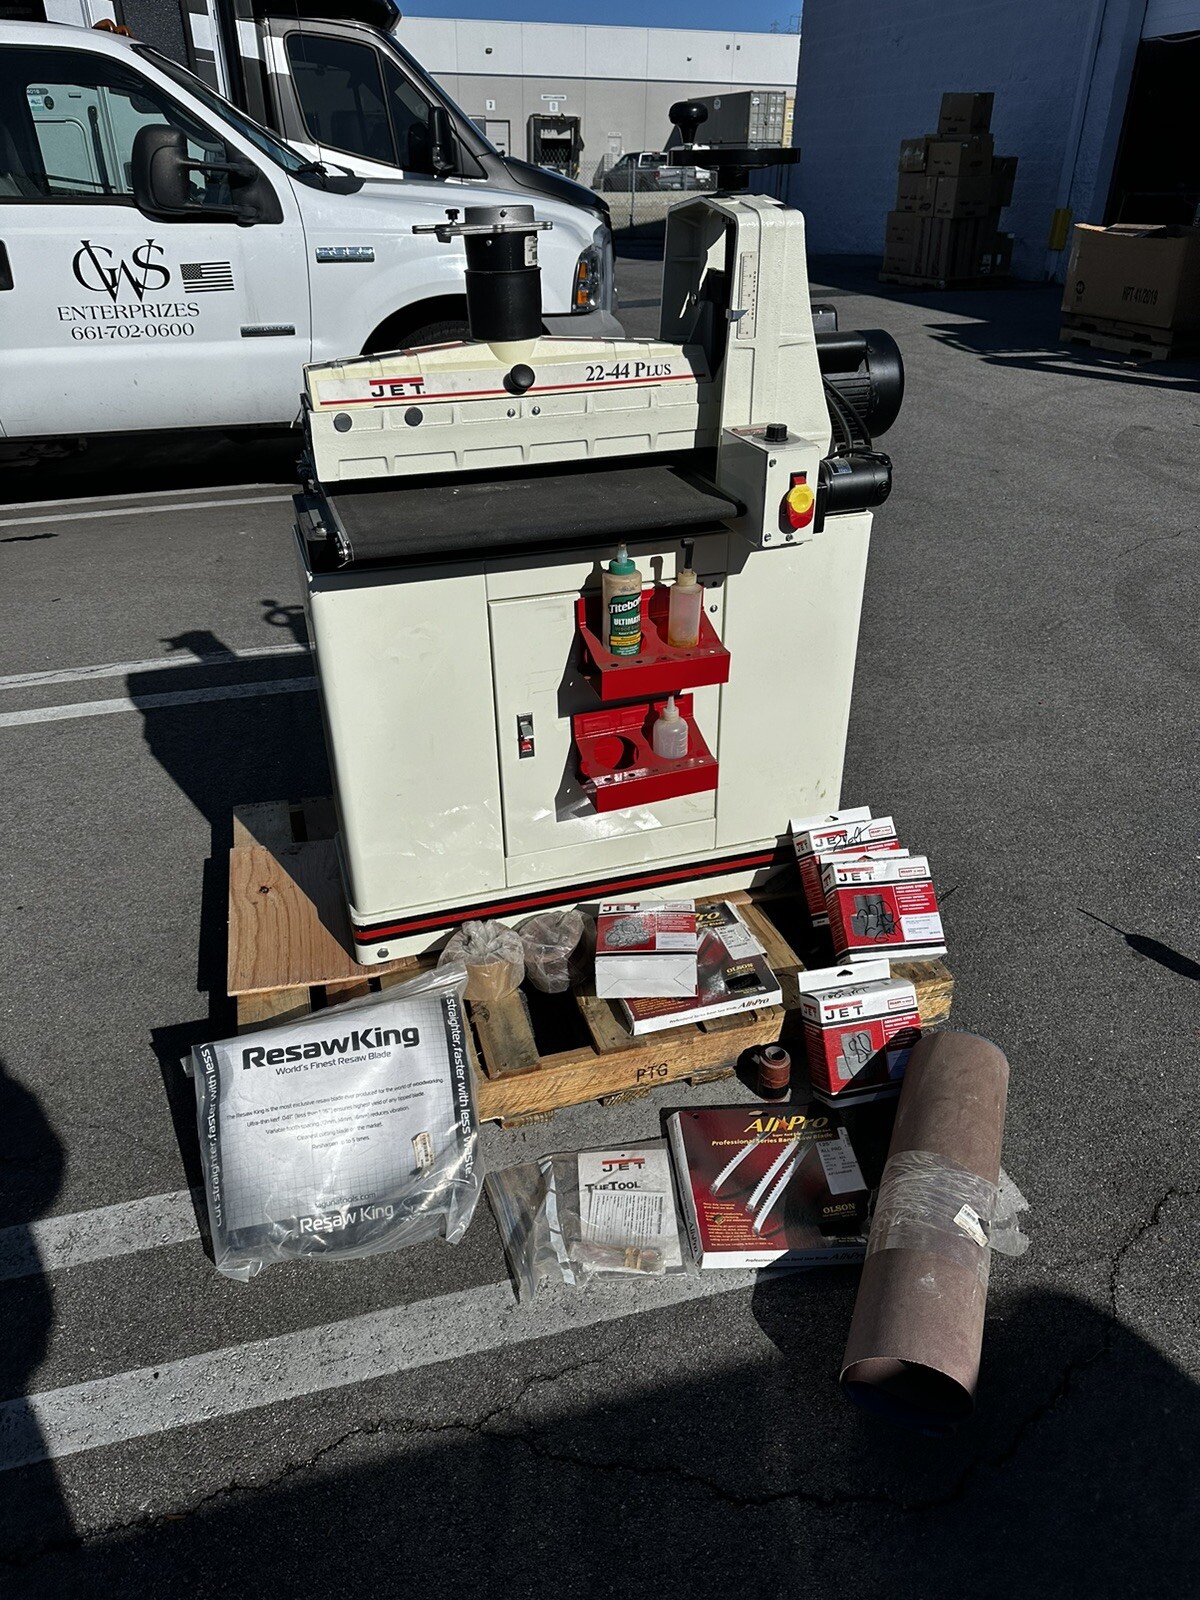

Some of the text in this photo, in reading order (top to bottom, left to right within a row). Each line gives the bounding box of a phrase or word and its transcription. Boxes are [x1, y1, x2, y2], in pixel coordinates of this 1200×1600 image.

[57, 302, 200, 321] ENTERPRIZES
[71, 322, 195, 341] 661-702-0600
[584, 362, 630, 382] 22-44
[371, 383, 425, 398] JET
[838, 871, 874, 882] JET
[804, 1008, 816, 1017] JET
[826, 1006, 863, 1020] JET
[242, 1026, 420, 1070] ResawKing
[201, 1050, 216, 1076] less
[310, 1060, 336, 1070] Finest
[340, 1055, 366, 1065] Resaw
[368, 1050, 392, 1060] Blade
[208, 1079, 218, 1101] with
[356, 1090, 378, 1098] produced
[458, 1080, 469, 1106] with
[460, 1108, 471, 1134] less
[602, 1161, 645, 1172] JET
[822, 1202, 856, 1215] OLSON
[300, 1204, 394, 1234] Resaw King
